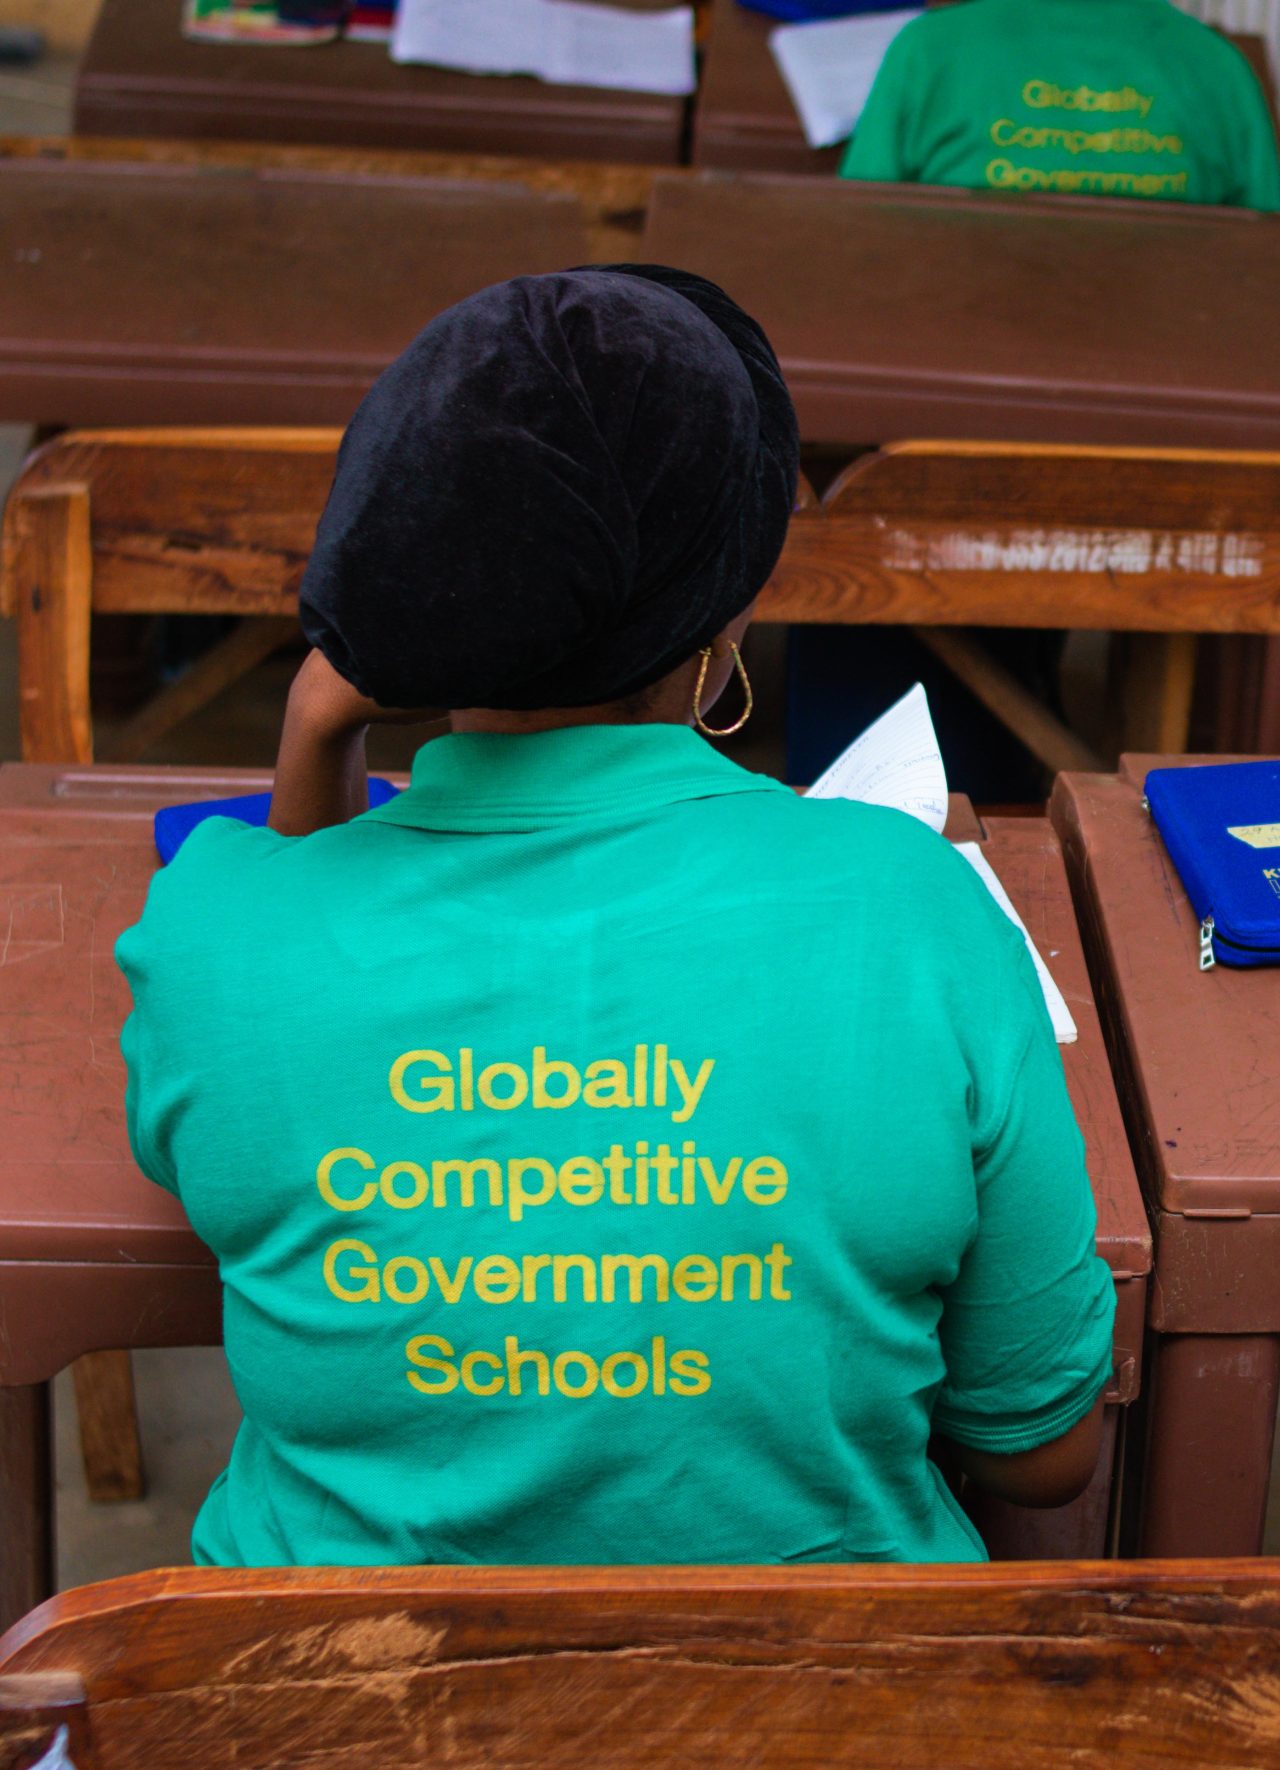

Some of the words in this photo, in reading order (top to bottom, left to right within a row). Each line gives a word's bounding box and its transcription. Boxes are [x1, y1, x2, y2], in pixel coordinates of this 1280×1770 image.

[1022, 79, 1153, 118] Globally
[990, 118, 1182, 154] Competitive
[986, 158, 1187, 194] Government
[388, 1043, 715, 1123] Globally
[316, 1140, 789, 1222] Competitive
[323, 1238, 793, 1304] Government
[405, 1334, 712, 1398] Schools
